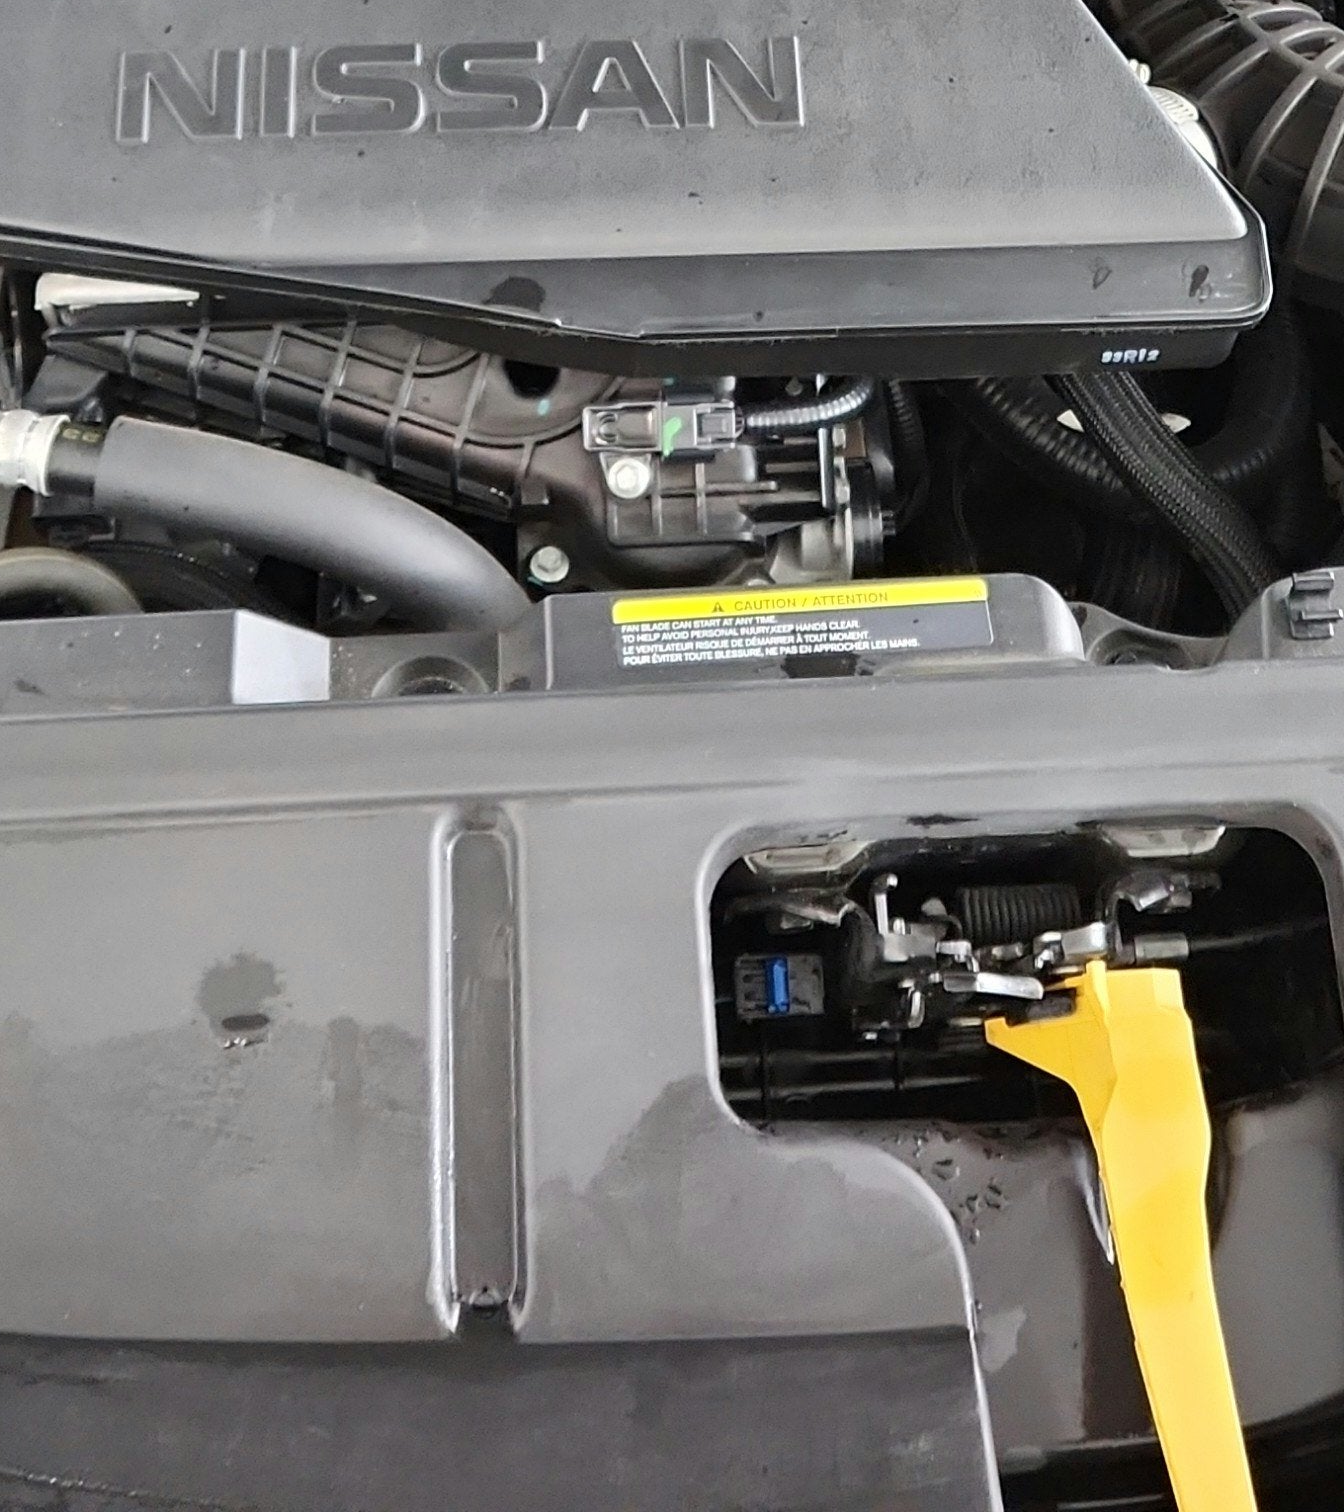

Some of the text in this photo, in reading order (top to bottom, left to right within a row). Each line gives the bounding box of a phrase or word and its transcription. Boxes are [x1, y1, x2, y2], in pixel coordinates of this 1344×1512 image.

[115, 35, 805, 143] NISSAN
[733, 597, 797, 611] CAUTION
[812, 592, 889, 606] ATTENTION
[621, 614, 778, 633] FAN BLADE CAN START AT ANY TIME.
[621, 634, 635, 643] TO
[636, 632, 659, 642] HELP
[661, 630, 690, 641] AVOID
[690, 627, 739, 639] PERSONAL
[795, 621, 828, 632] HANDS
[829, 619, 860, 629] CLEAR.
[623, 630, 870, 655] LE VENTILATEUR RISQUE DE DÉMARRER À TOUT MOMENT.
[623, 638, 920, 666] POUR ÉVITER TOUTE BLESSURE, NE PAS EN APPROCHER LES MAINS.
